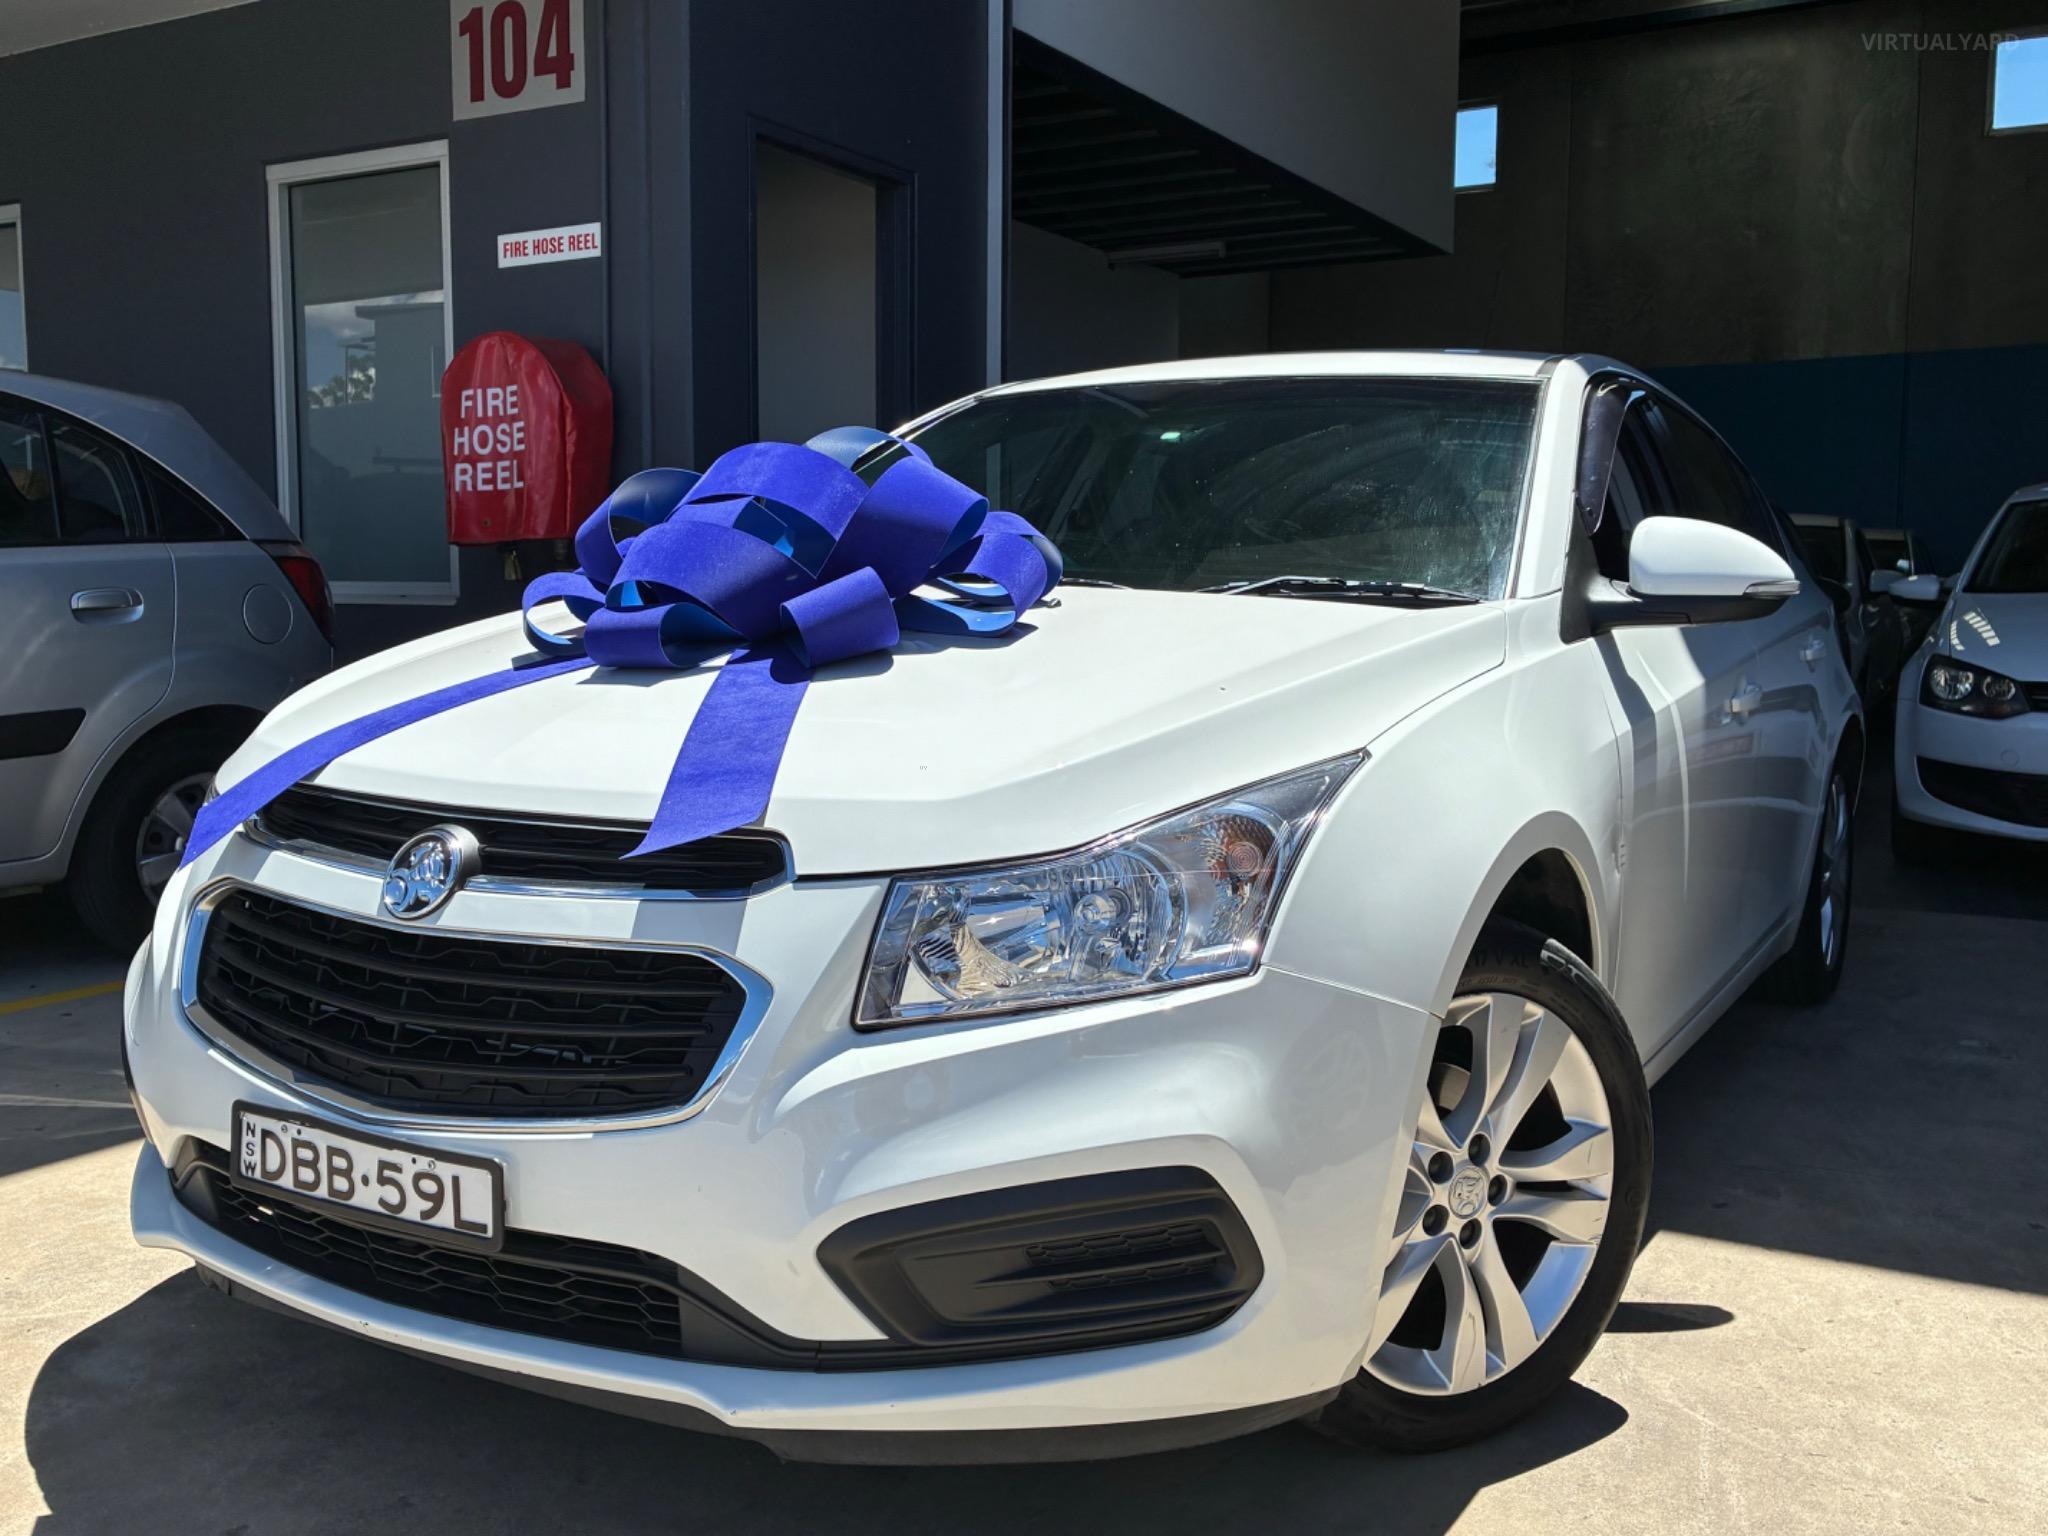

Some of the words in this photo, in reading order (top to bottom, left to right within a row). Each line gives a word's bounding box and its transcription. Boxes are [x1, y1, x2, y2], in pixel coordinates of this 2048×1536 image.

[459, 0, 574, 103] 104
[503, 240, 529, 259] FIRE
[532, 236, 565, 256] HOSE
[568, 232, 598, 252] REEL
[460, 384, 519, 419] FIRE
[453, 421, 526, 456] HOSE
[454, 459, 524, 492] REEL
